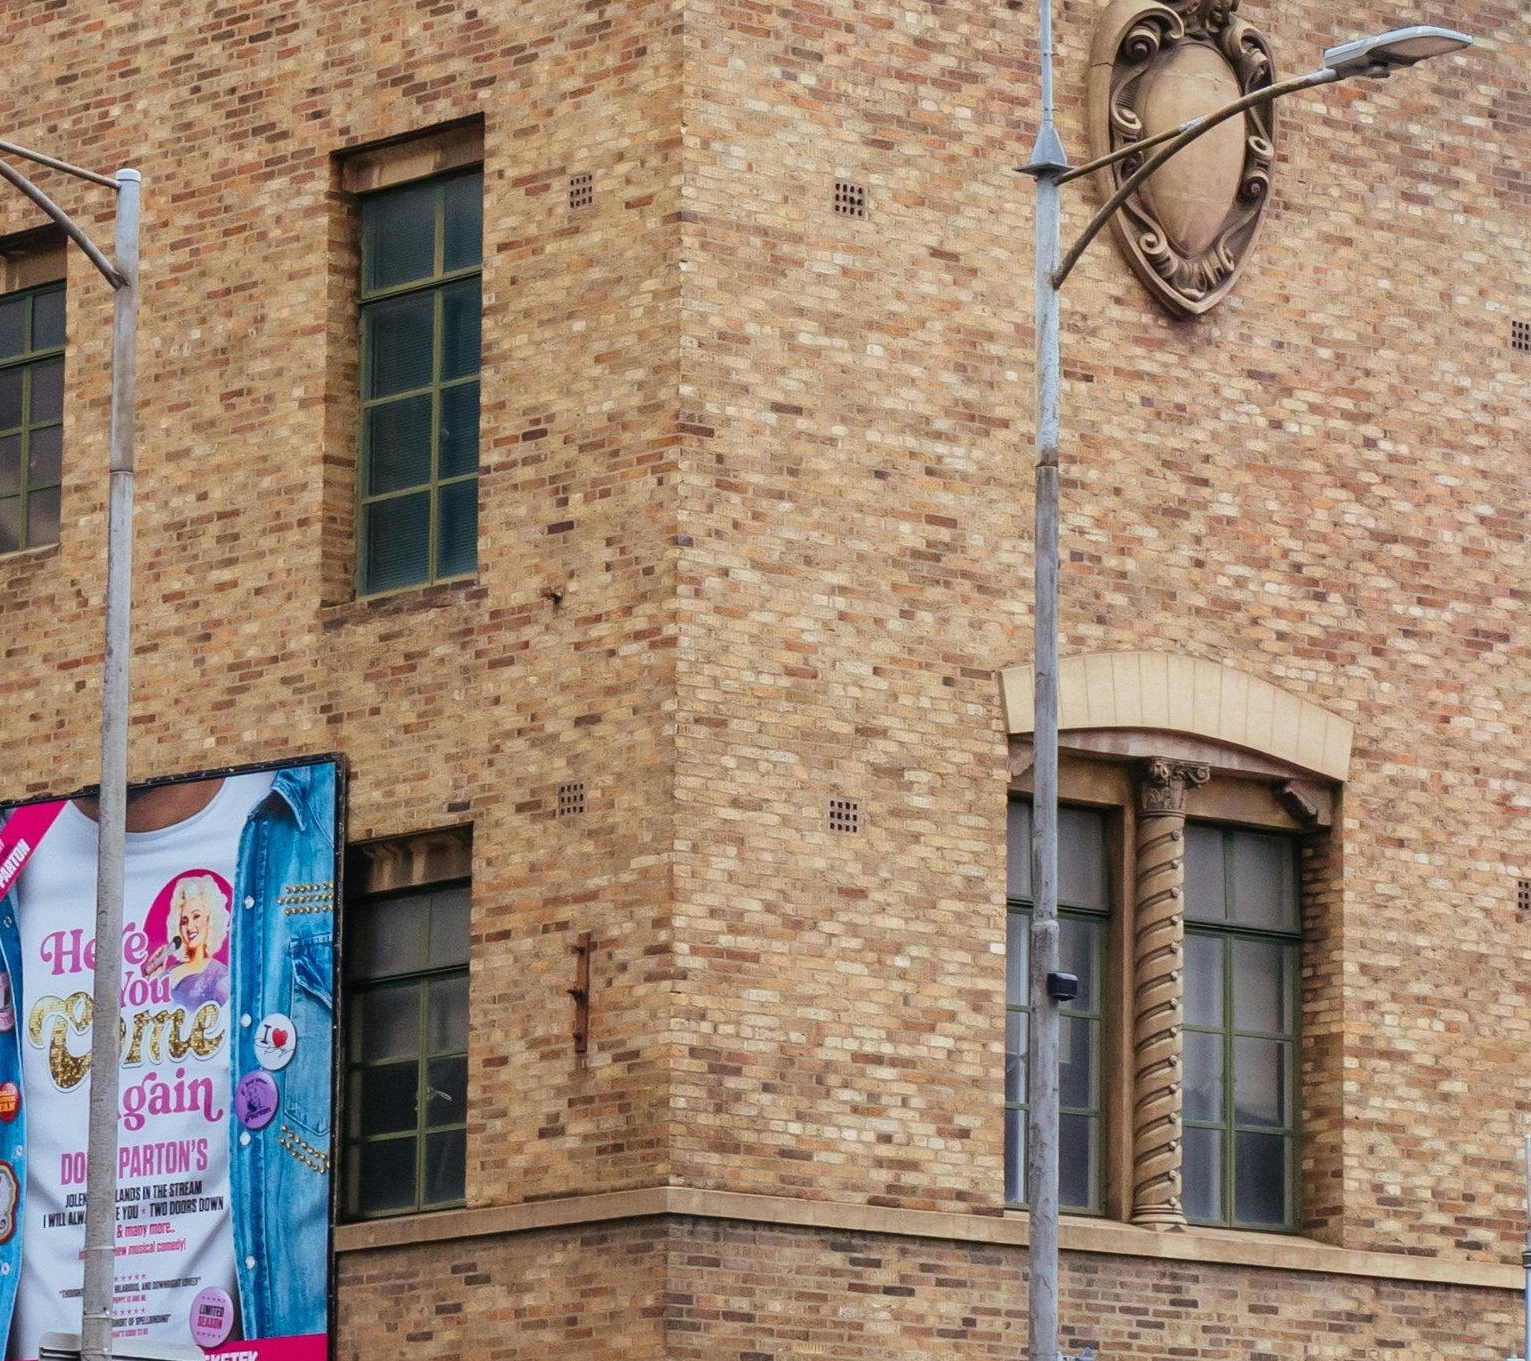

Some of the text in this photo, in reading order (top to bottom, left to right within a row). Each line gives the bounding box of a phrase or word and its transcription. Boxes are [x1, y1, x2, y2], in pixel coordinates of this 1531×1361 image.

[40, 922, 148, 975] Hee
[28, 991, 226, 1090] Cme
[260, 1024, 271, 1044] I
[120, 1067, 224, 1131] gain
[118, 1138, 208, 1179] PARTON'S
[65, 1180, 202, 1208] JOLE LANDS IN THE STREAM
[48, 1212, 66, 1227] WILL
[68, 1210, 86, 1225] ALW
[123, 1206, 138, 1220] YOU
[150, 1202, 167, 1217] TWO
[169, 1199, 197, 1215] DOORS
[199, 1196, 224, 1212] DOWN
[116, 1224, 122, 1238] &
[125, 1224, 147, 1239] many
[128, 1242, 156, 1255] musical
[157, 1238, 186, 1253] comedy!
